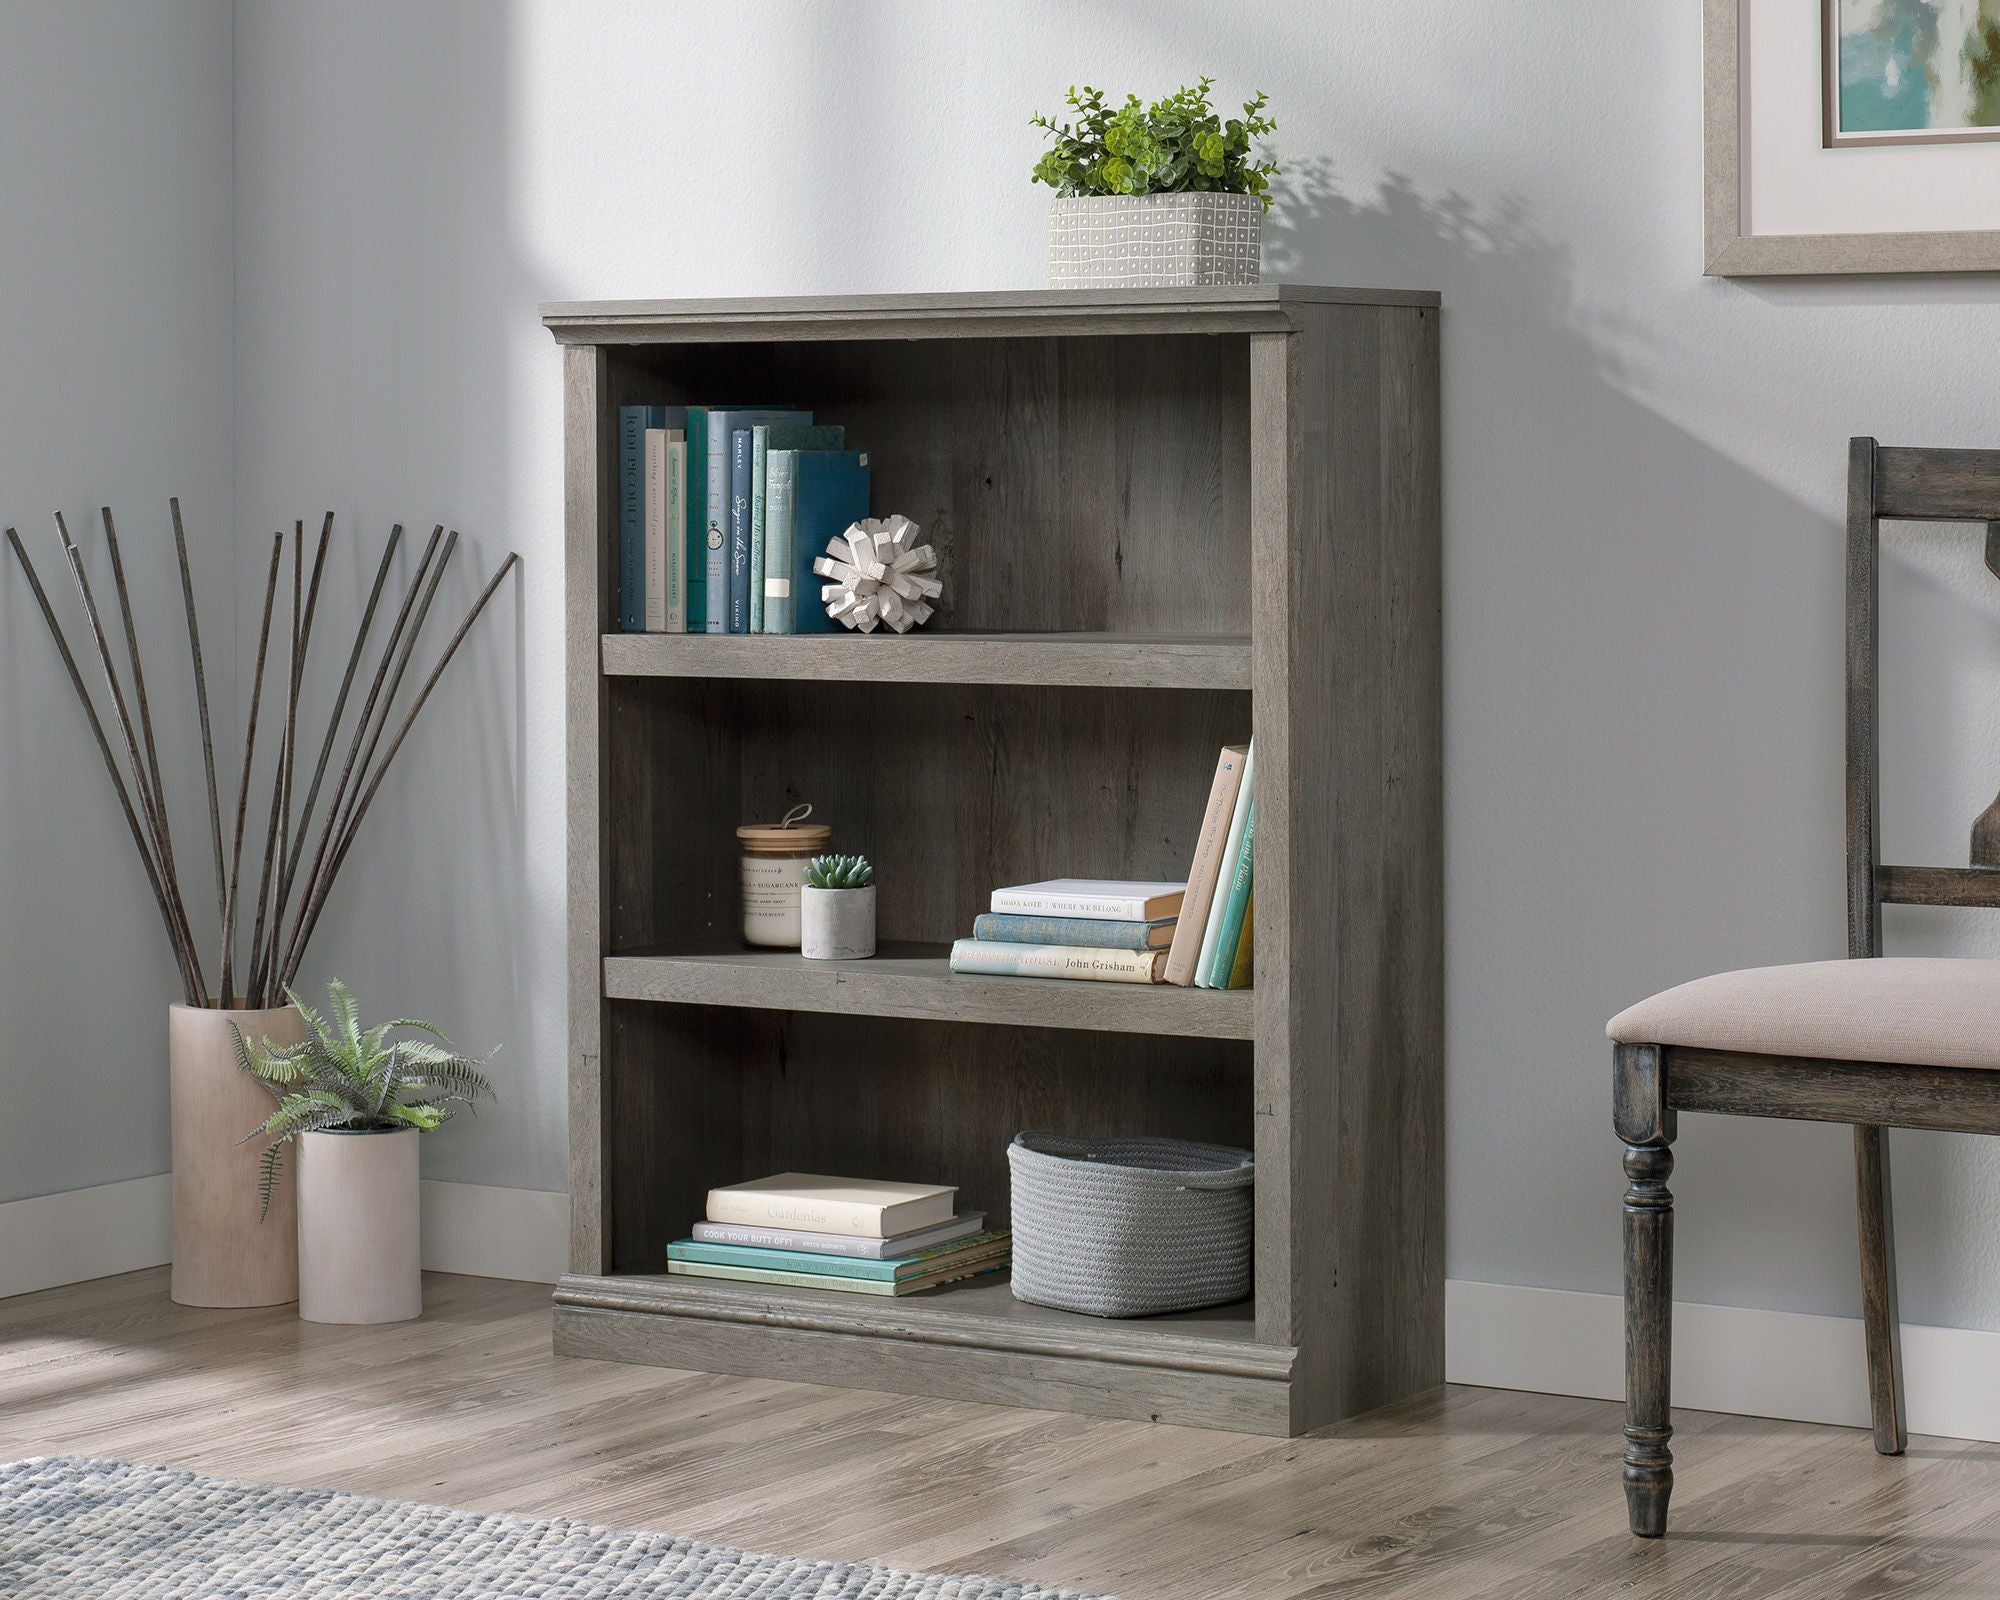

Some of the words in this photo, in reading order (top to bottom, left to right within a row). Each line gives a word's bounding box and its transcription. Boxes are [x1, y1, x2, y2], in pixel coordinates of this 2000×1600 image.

[626, 415, 637, 450] JODI
[626, 458, 637, 527] PICOULT
[754, 524, 762, 537] His
[735, 536, 748, 552] the
[1065, 957, 1089, 969] John
[1091, 959, 1135, 972] Grisham
[767, 1204, 827, 1224] Gardenias
[703, 1230, 725, 1240] COOK
[727, 1232, 749, 1242] YOUR
[750, 1234, 773, 1245] BUTT
[774, 1236, 793, 1247] OFF!
